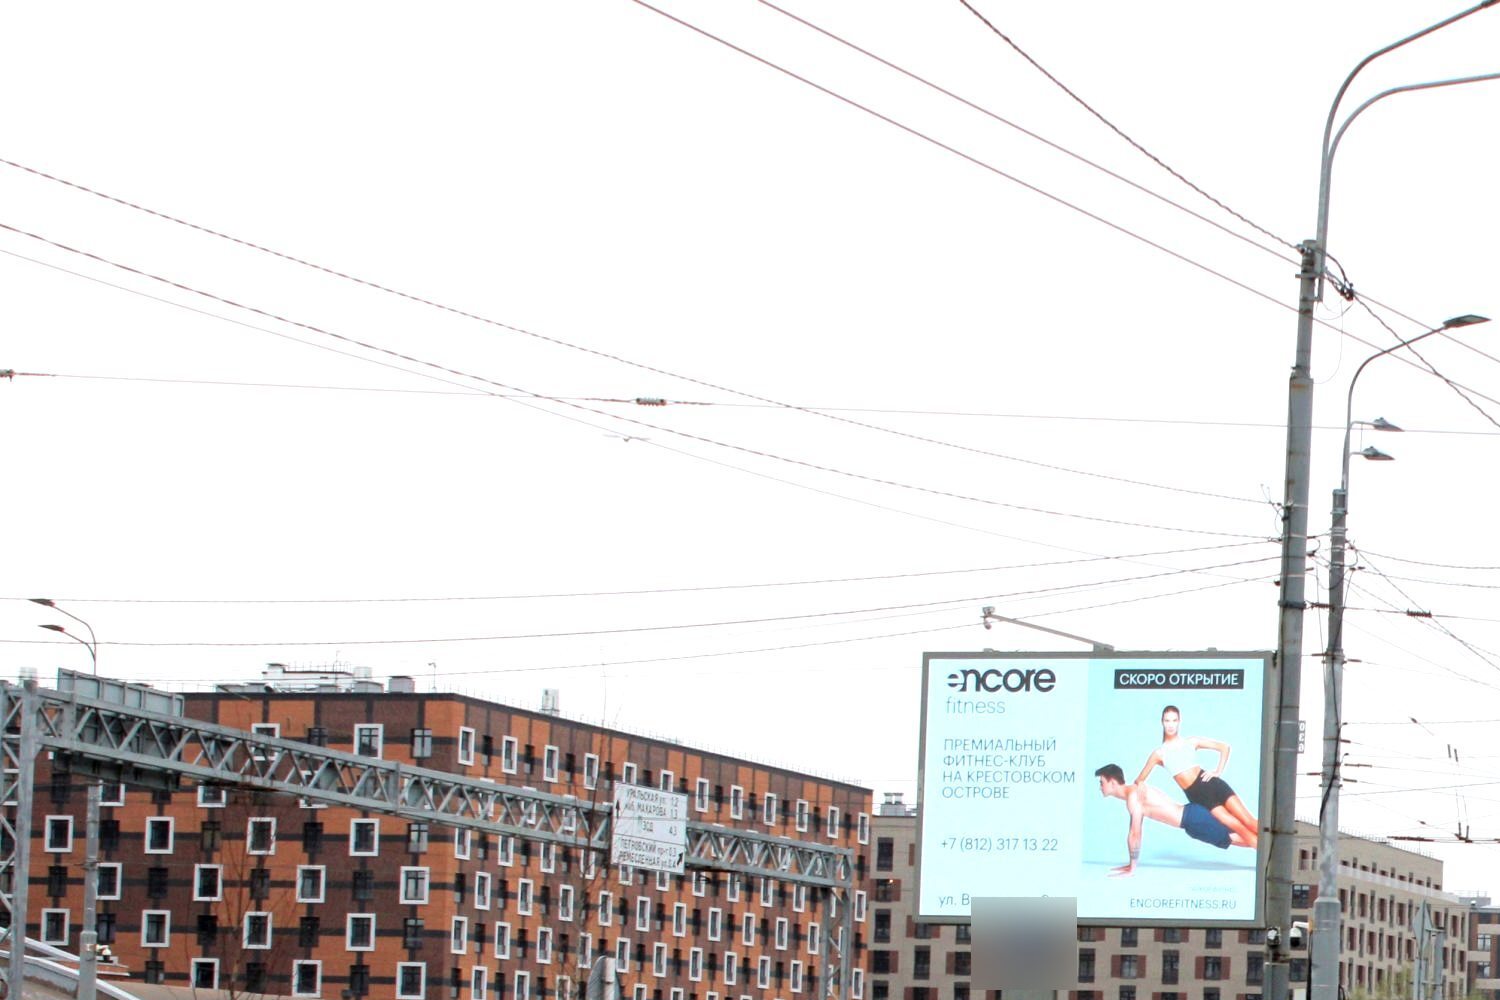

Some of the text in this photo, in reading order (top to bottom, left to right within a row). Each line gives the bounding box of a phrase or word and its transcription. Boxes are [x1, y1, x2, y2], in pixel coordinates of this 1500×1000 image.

[947, 668, 1056, 693] encore
[1119, 672, 1240, 687] СКОРО ОТКРЫТИЕ
[946, 696, 1006, 714] fitness
[943, 737, 1056, 752] ПРЕМИАЛЬНЫЙ
[943, 754, 1046, 768] ФИТНЕС-КЛУБ
[943, 770, 1076, 784] НА КРЕСТОВСКОМ
[942, 786, 1010, 799] ОСТРОВЕ
[941, 837, 1058, 852] +7 (812) 317 13 22
[1130, 898, 1237, 910] ENCOREFITNESS.RU
